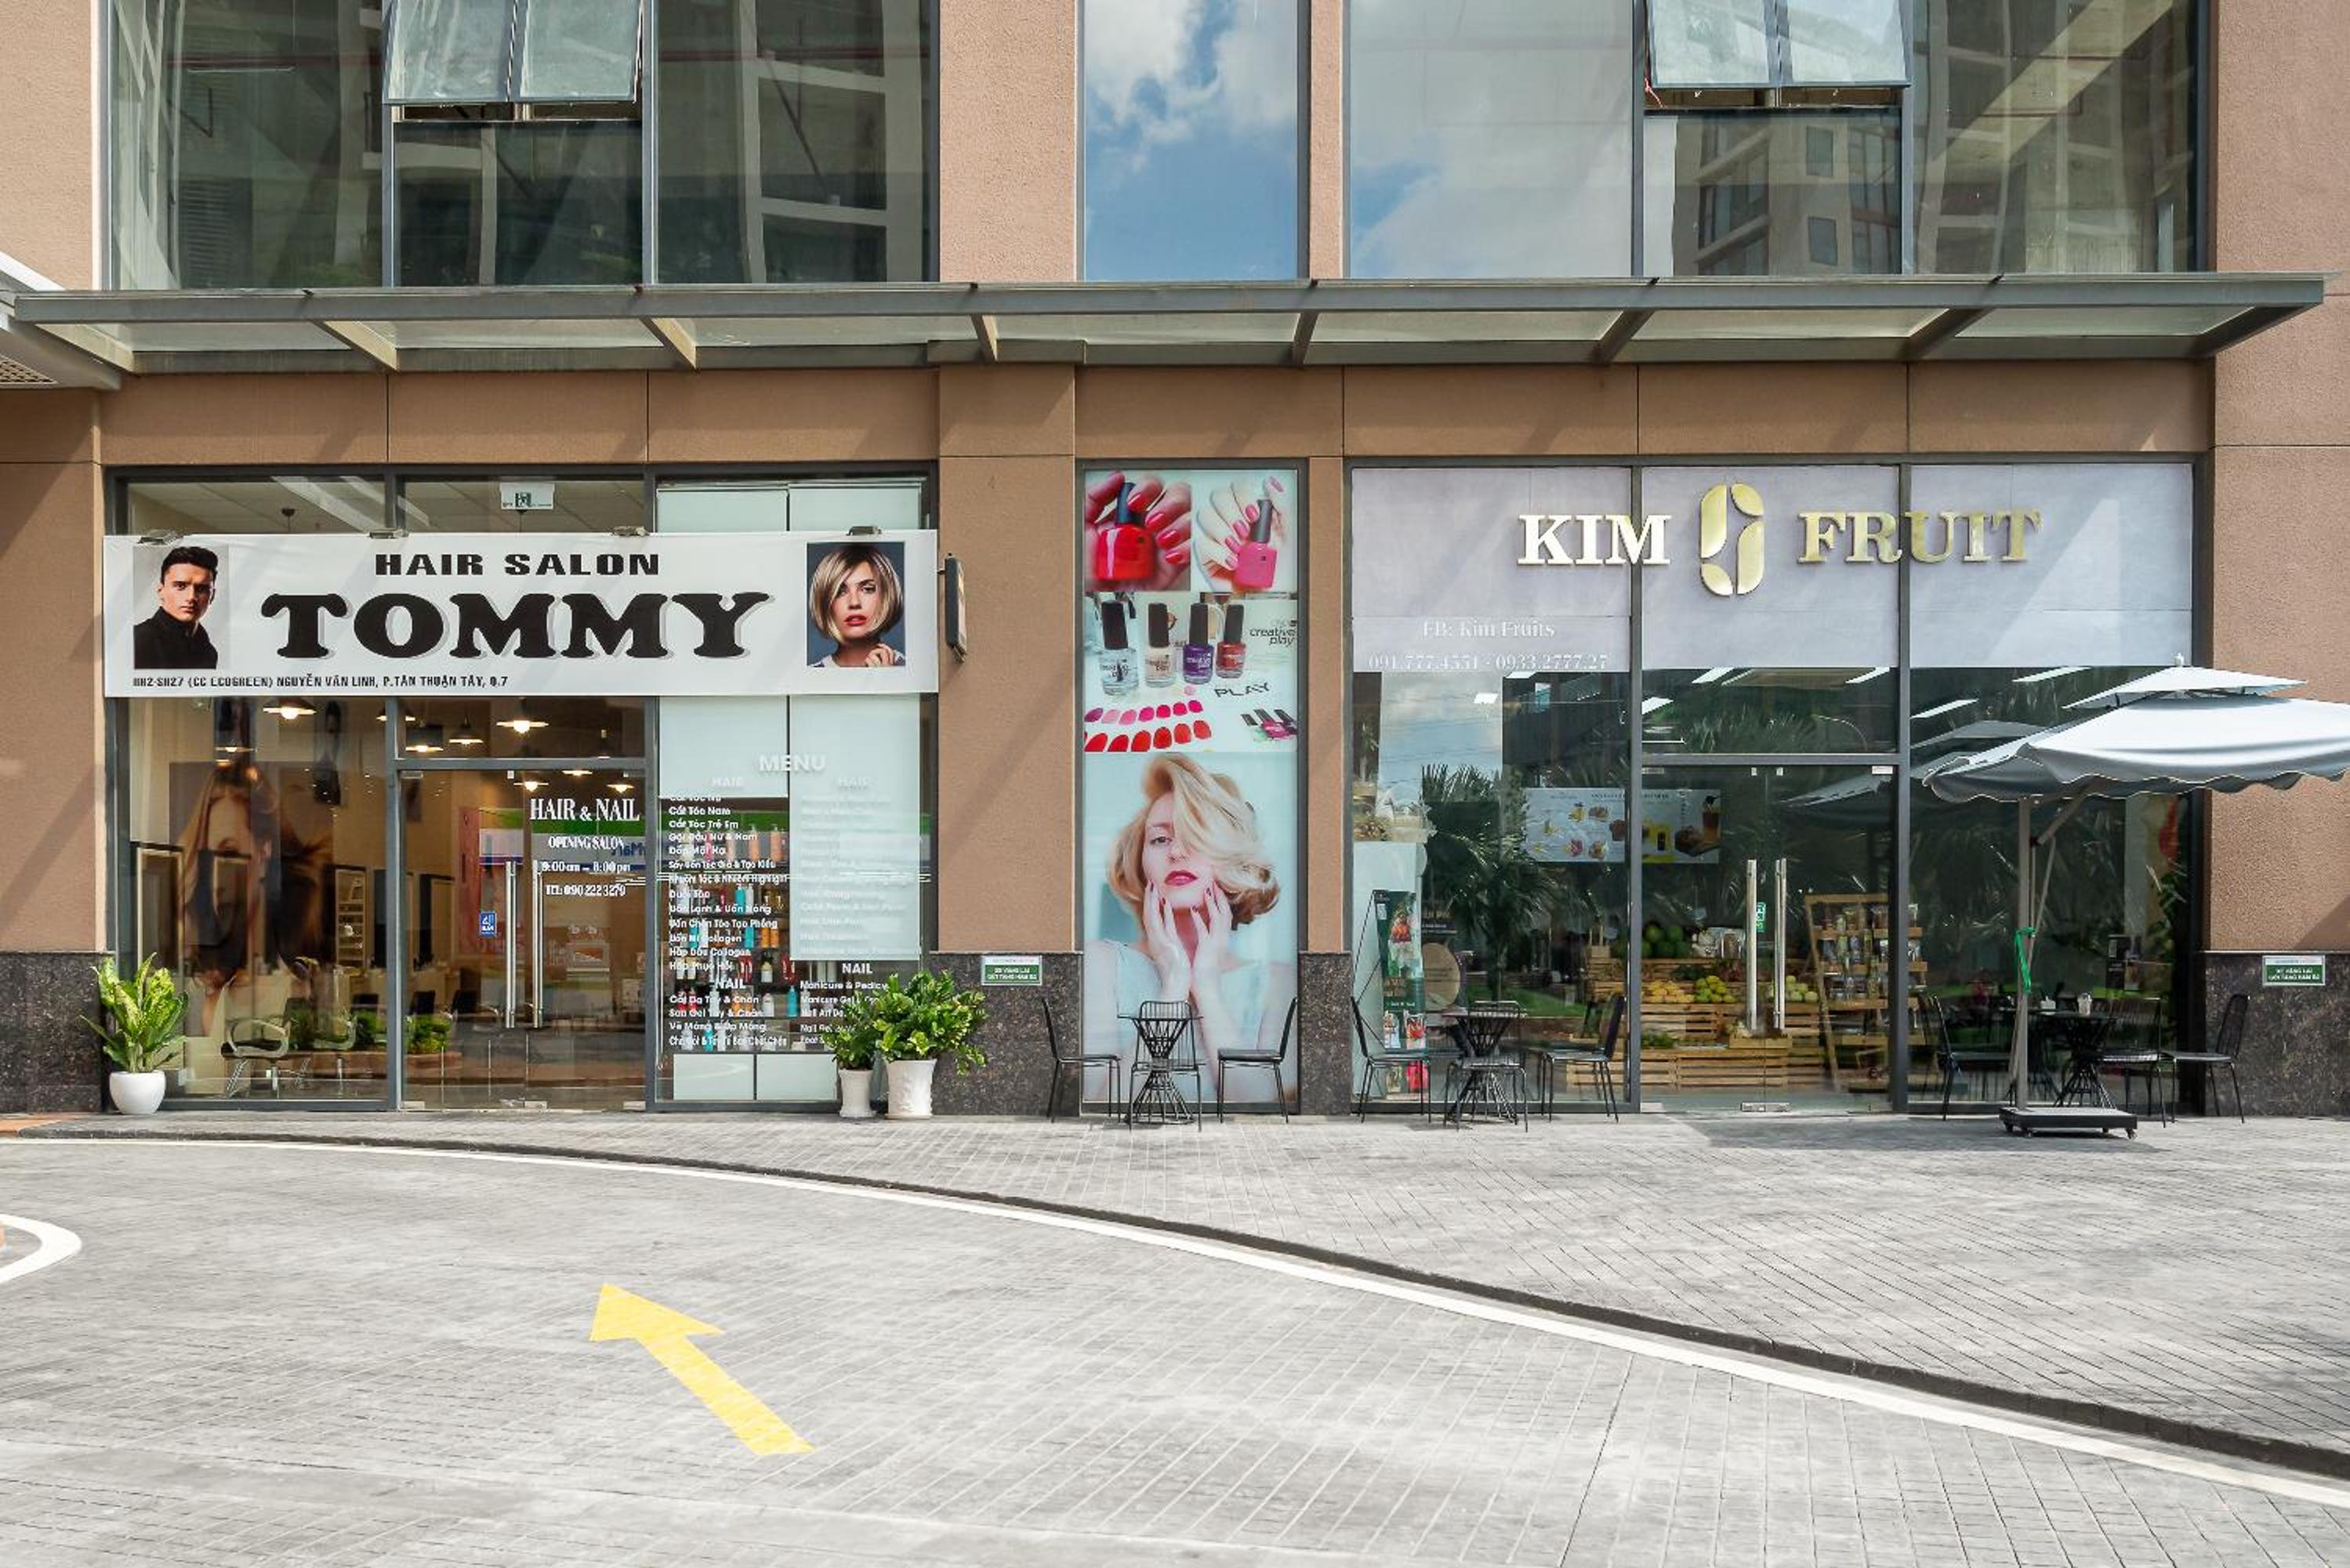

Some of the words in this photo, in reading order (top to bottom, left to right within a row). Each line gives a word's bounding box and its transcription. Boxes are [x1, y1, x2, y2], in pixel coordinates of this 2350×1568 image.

[1518, 514, 1671, 566] KIM
[1797, 511, 2042, 564] FRUIT
[375, 553, 484, 576] HAIR
[505, 552, 660, 576] SALON
[261, 592, 774, 659] TOMMY
[1423, 619, 1453, 637] FB:
[1460, 617, 1497, 637] Kim
[1500, 618, 1556, 638] Fruits
[276, 673, 322, 687] NGUYỄN
[325, 675, 349, 687] VĂN
[352, 675, 379, 688] LINH,
[758, 754, 828, 773] MENU
[529, 798, 576, 821] HAIR
[579, 806, 593, 822] &
[595, 798, 640, 822] NAIL
[707, 806, 731, 816] Nam
[842, 962, 873, 974] NAIL
[715, 978, 747, 990] NAIL
[800, 980, 844, 990] Manicure
